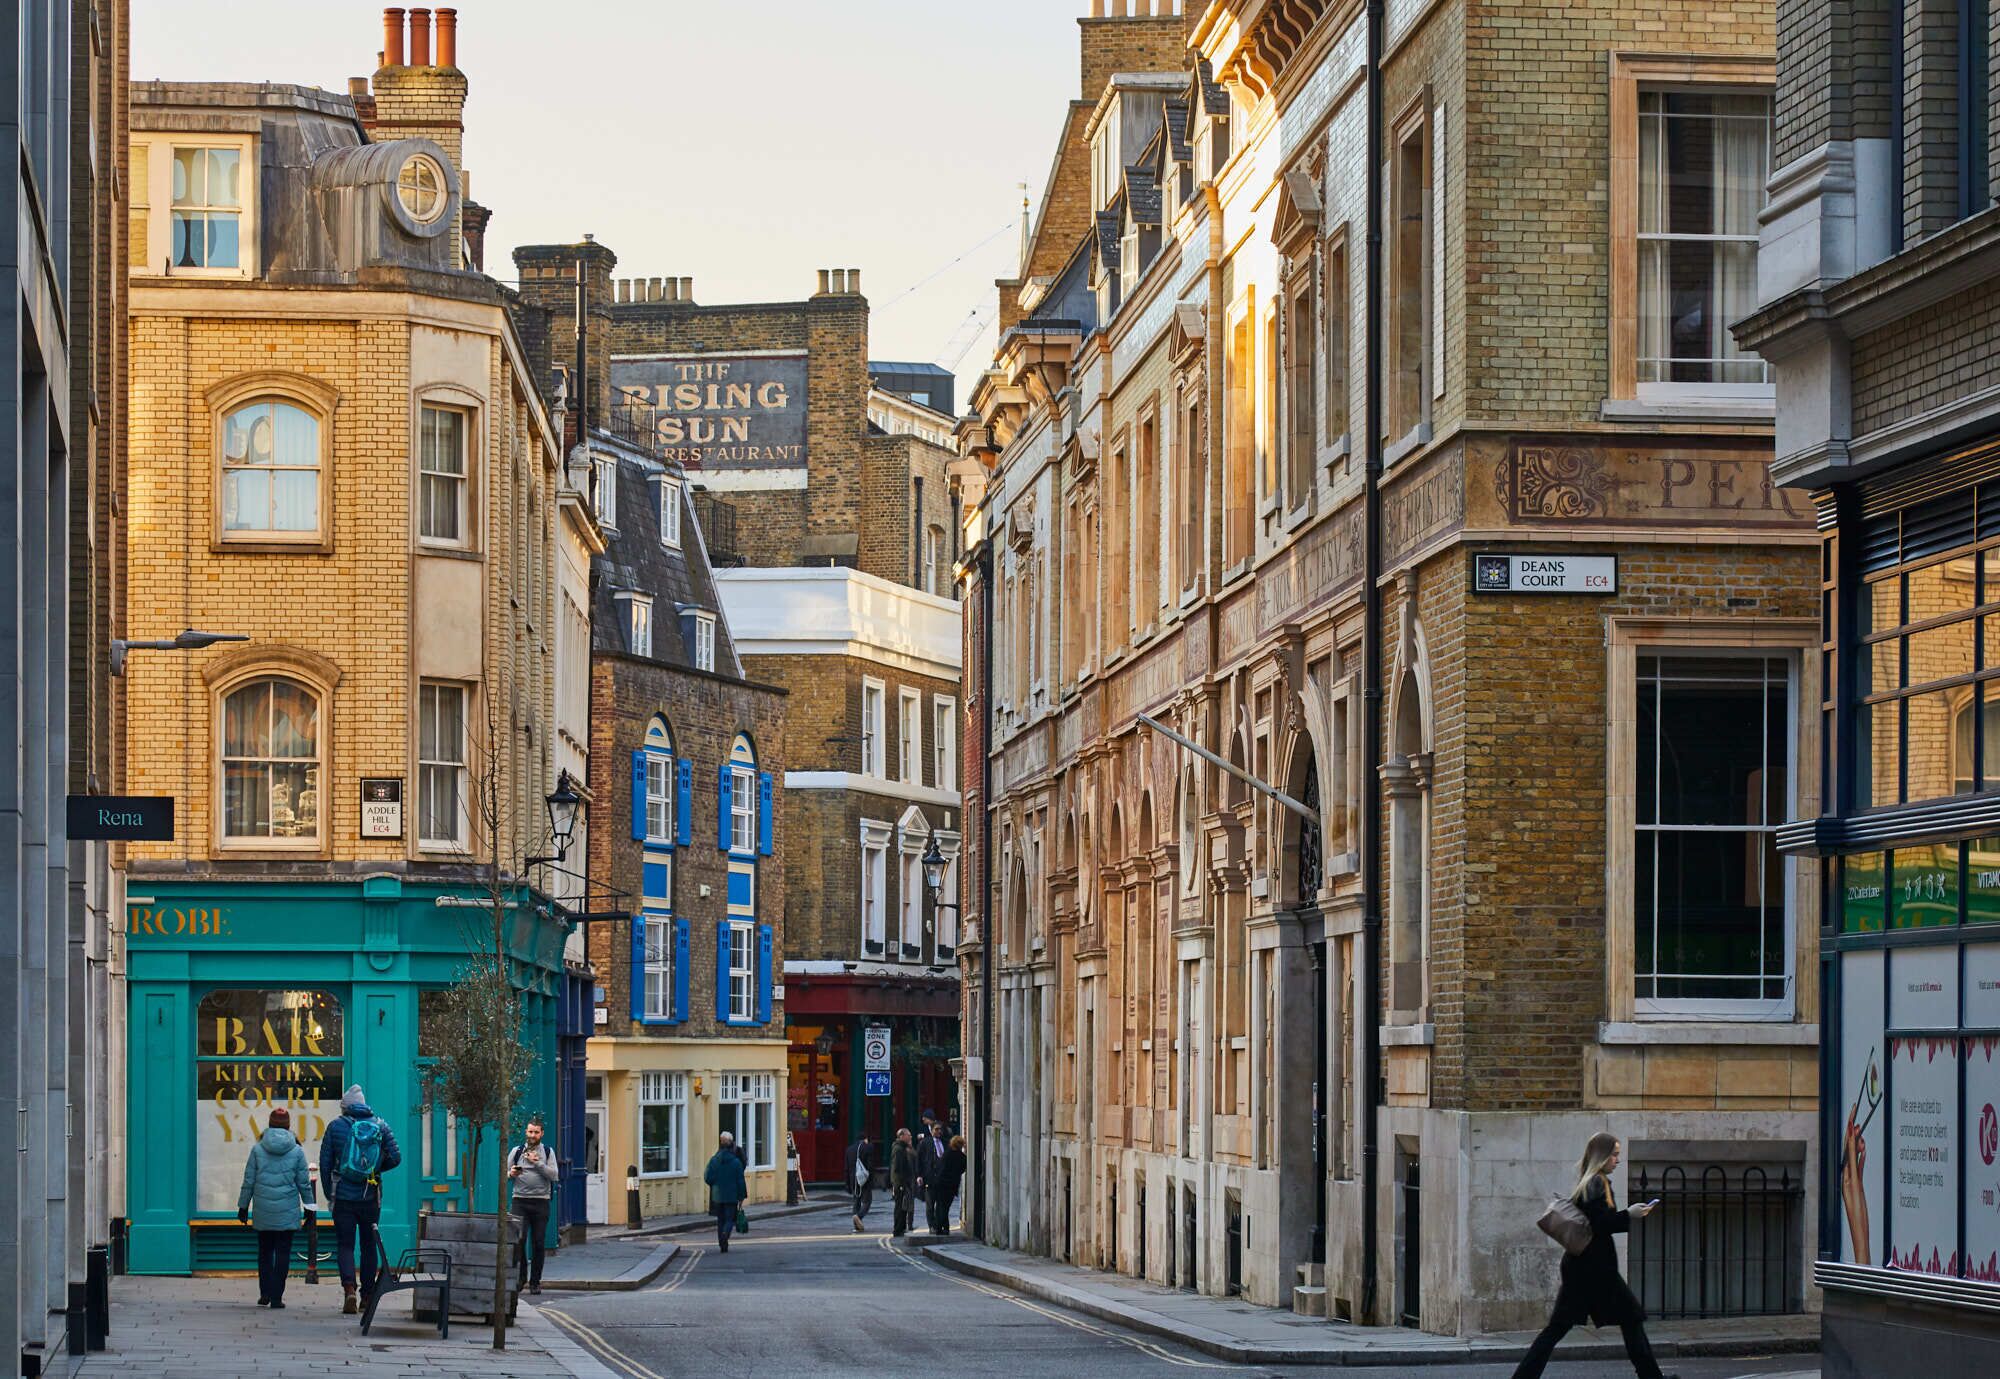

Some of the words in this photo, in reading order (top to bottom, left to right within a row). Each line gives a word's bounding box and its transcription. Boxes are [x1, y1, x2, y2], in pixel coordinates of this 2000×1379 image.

[620, 381, 790, 411] RISING
[657, 415, 752, 445] SUN
[663, 445, 803, 462] RESTAURANT
[1521, 561, 1565, 572] DEANS
[1521, 575, 1566, 587] COURT
[1585, 576, 1609, 587] EC4
[98, 809, 143, 826] Rena
[367, 807, 397, 815] ADDLE
[373, 825, 390, 833] EC4
[215, 1017, 324, 1055] BAR
[215, 1064, 325, 1082] KITCHEN
[215, 1087, 327, 1109] COURT
[215, 1114, 326, 1143] YAD
[1900, 1125, 1924, 1138] announce
[1924, 1126, 1933, 1138] our
[1928, 1146, 1939, 1162] K10
